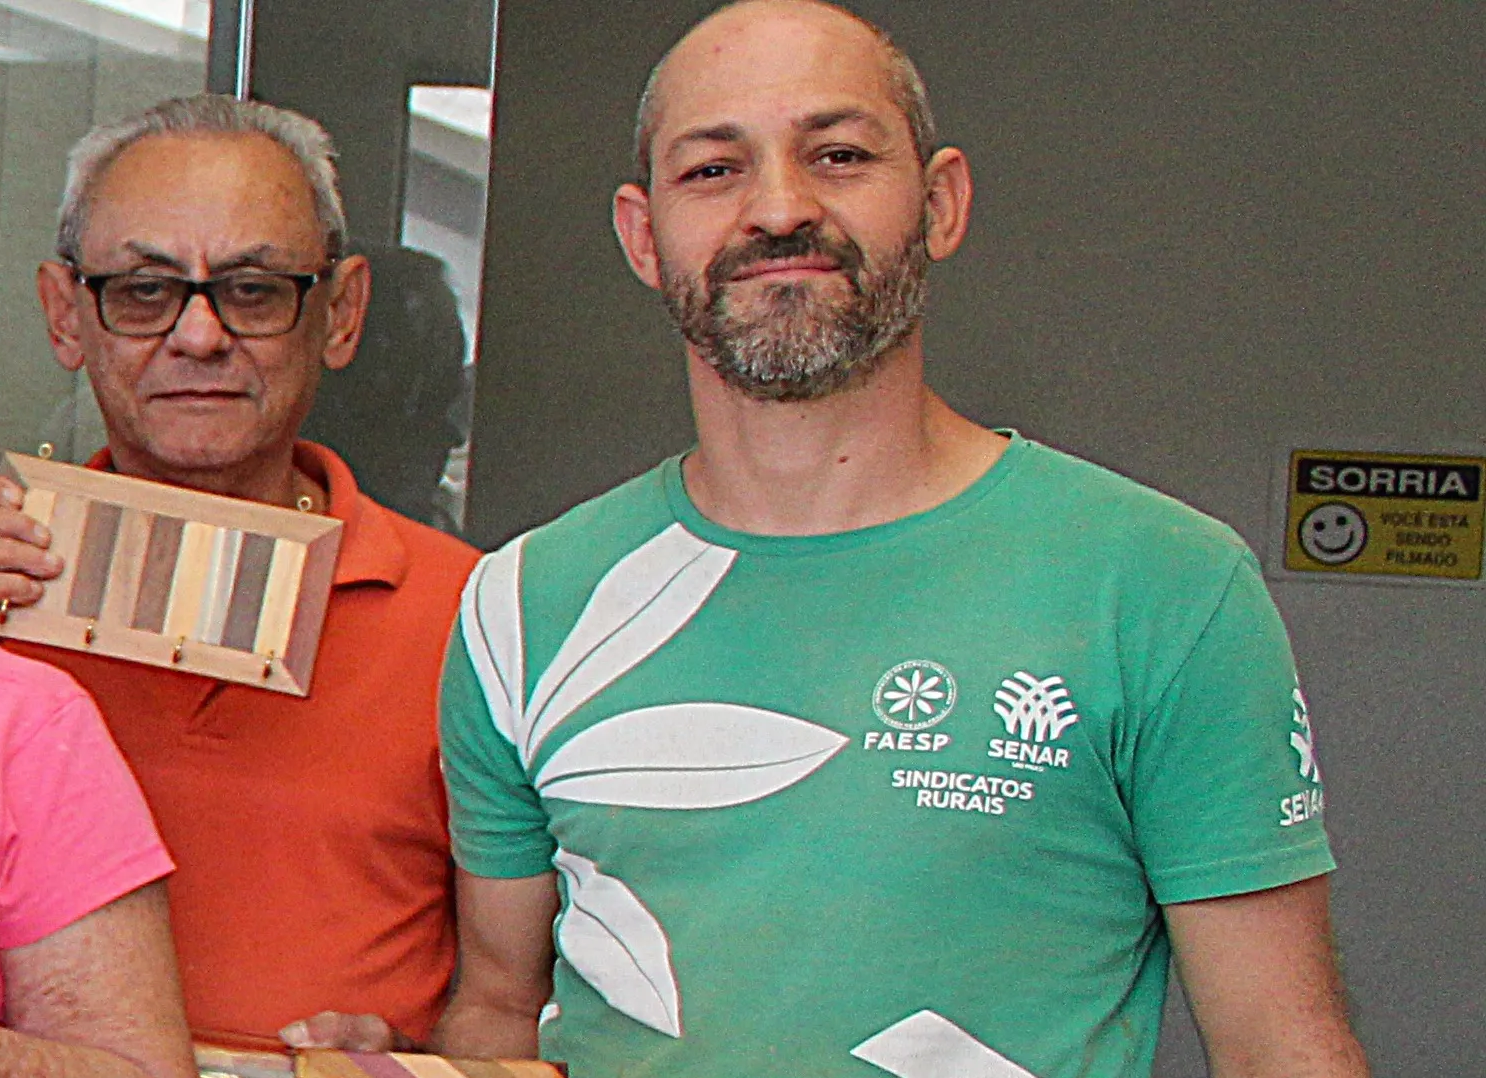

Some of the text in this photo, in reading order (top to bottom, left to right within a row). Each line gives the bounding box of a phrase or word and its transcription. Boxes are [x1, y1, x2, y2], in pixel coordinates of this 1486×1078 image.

[1309, 464, 1468, 497] SORRIA
[863, 731, 950, 752] FAESP
[987, 738, 1070, 768] SENAR
[891, 769, 1035, 801] SINDICATOS
[916, 789, 1006, 816] RURAIS
